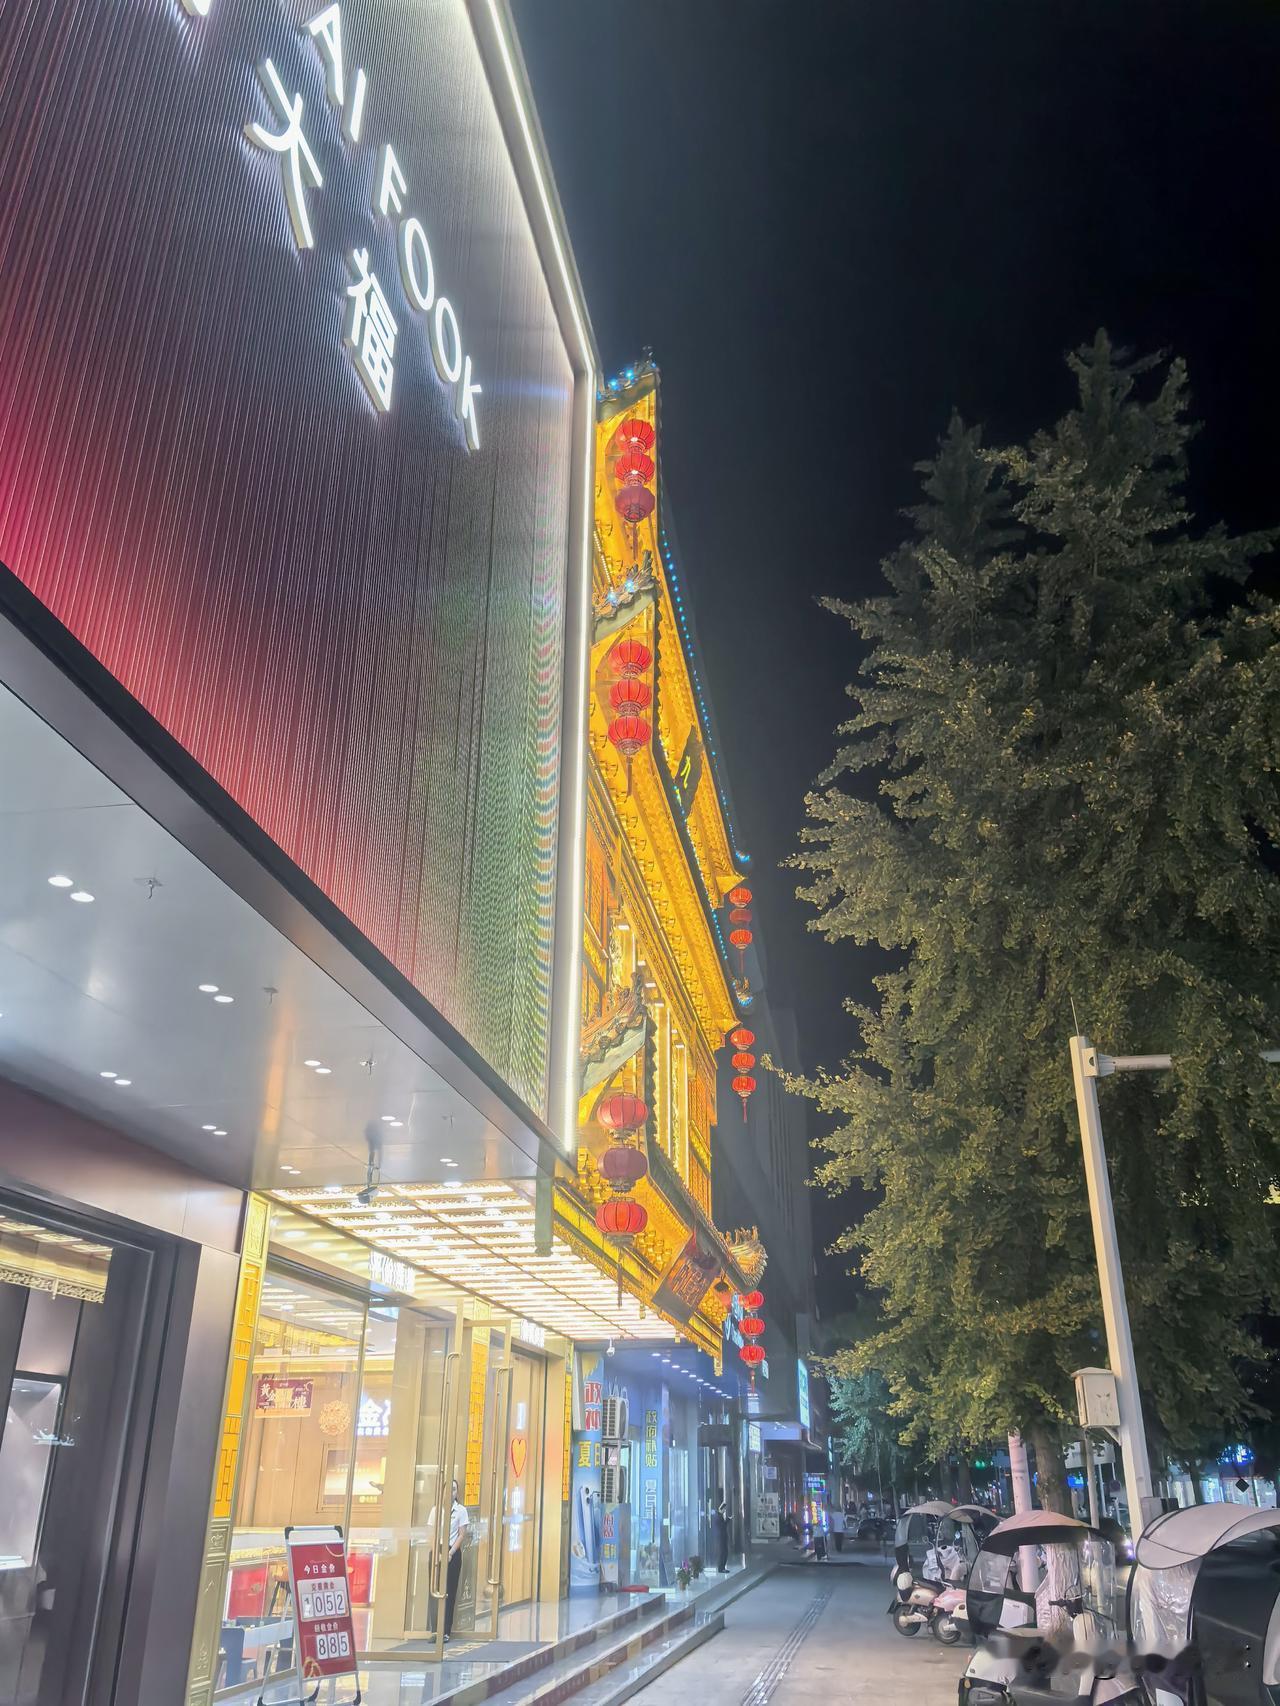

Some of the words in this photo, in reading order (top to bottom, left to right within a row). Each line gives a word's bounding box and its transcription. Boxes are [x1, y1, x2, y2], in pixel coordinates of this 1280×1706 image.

[181, 0, 398, 412] 大福
[378, 143, 482, 450] FOOK
[318, 1635, 348, 1656] 885
